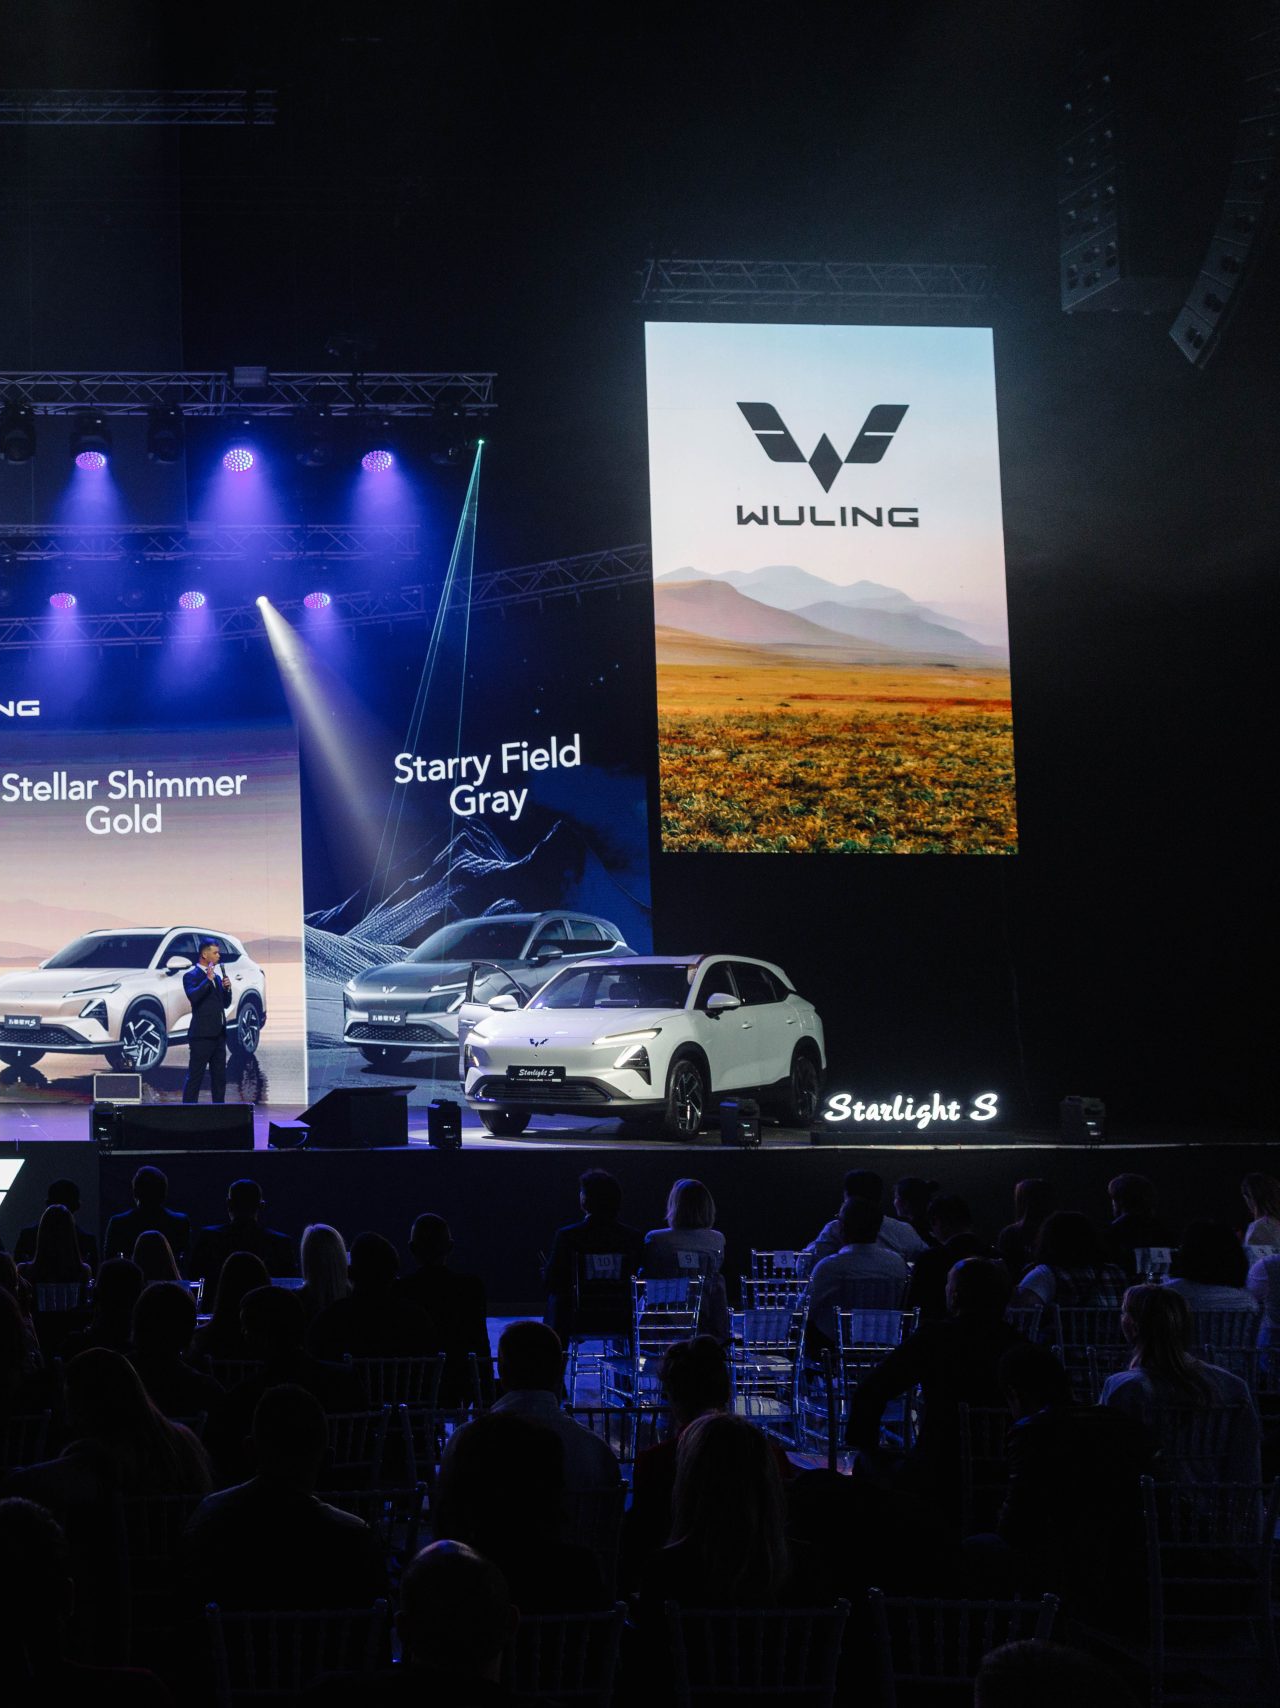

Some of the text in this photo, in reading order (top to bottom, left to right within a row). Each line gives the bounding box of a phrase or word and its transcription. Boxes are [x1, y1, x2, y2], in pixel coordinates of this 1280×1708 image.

[736, 505, 920, 528] WULING
[394, 733, 582, 787] Starry Field
[1, 769, 248, 802] Stellar Shimmer
[85, 803, 162, 835] Gold
[449, 784, 529, 821] Gray
[518, 1068, 555, 1078] Starlight S
[824, 1092, 999, 1130] Starlight S
